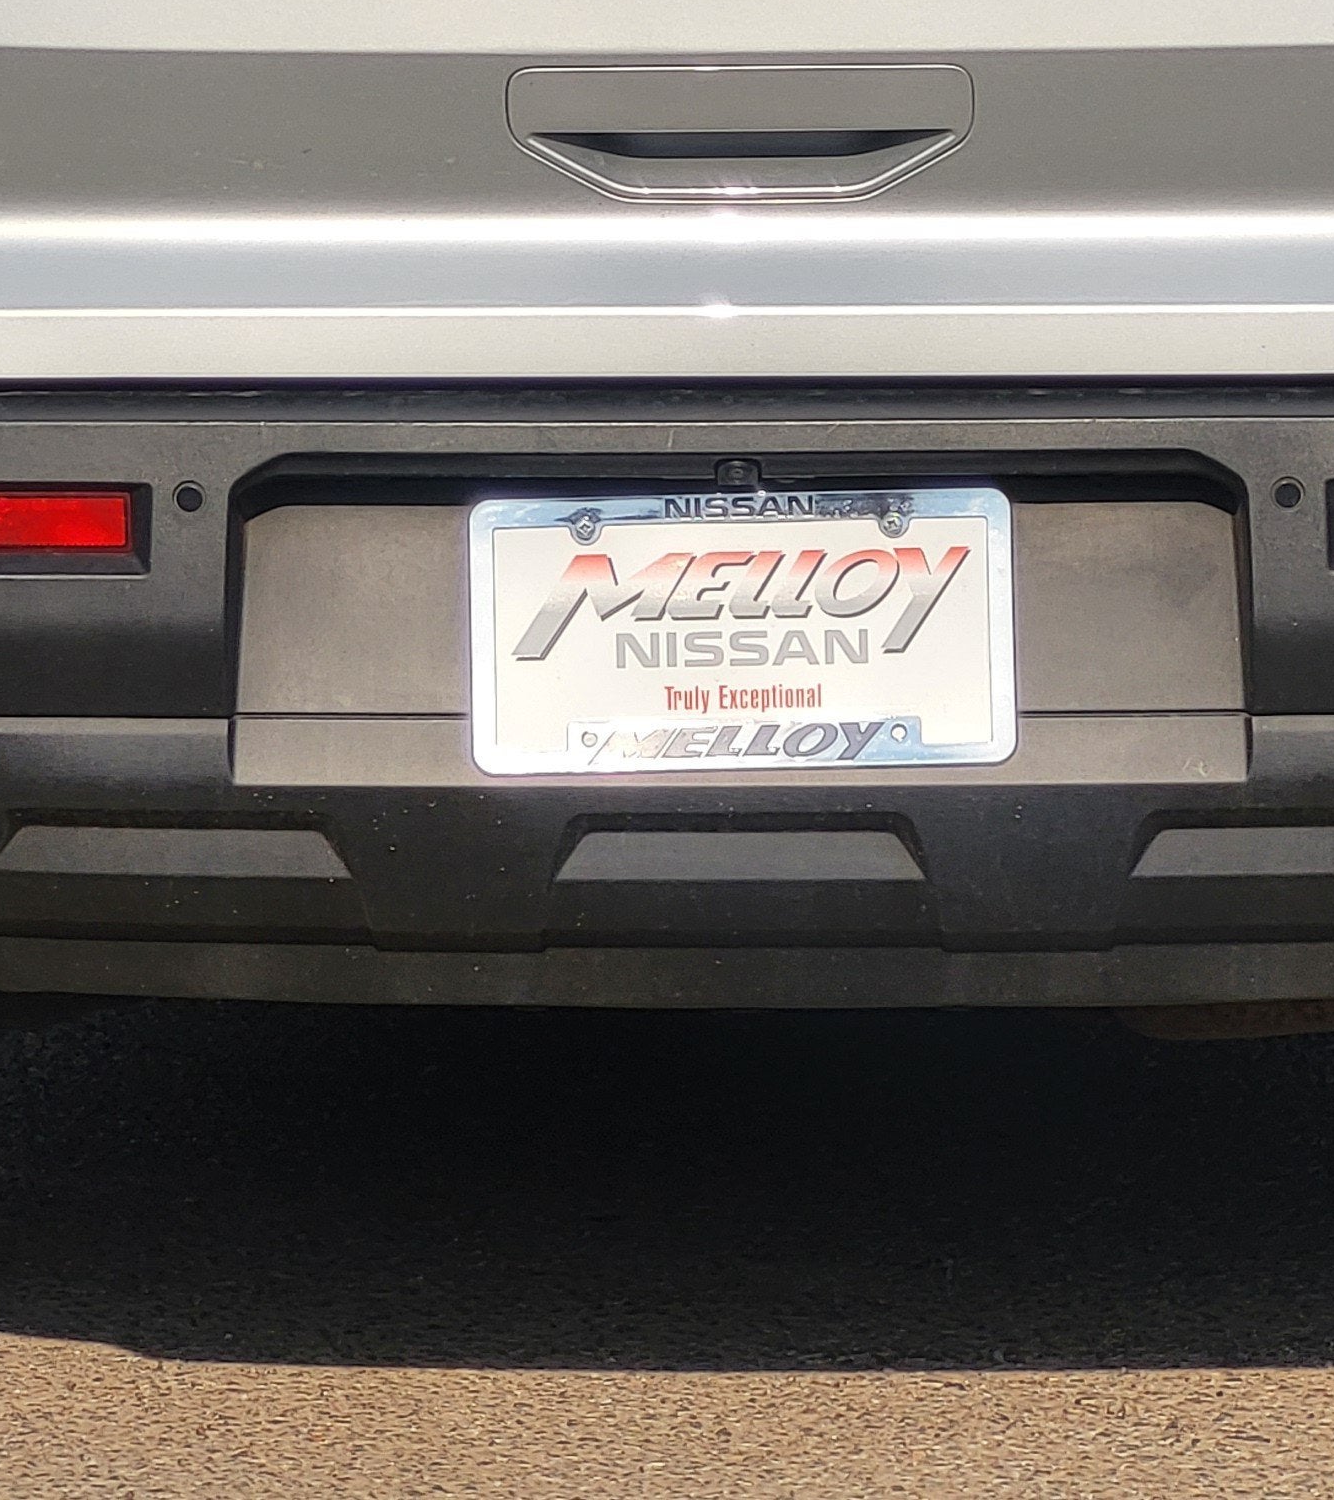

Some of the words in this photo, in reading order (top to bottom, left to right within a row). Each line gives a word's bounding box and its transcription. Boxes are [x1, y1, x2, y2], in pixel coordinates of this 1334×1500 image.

[664, 495, 816, 520] NISSAN
[512, 545, 971, 662] MELLOY
[615, 628, 869, 669] NISSAN
[664, 686, 710, 713] Truly
[719, 684, 823, 713] Exceptional
[587, 721, 886, 766] MELLOY
